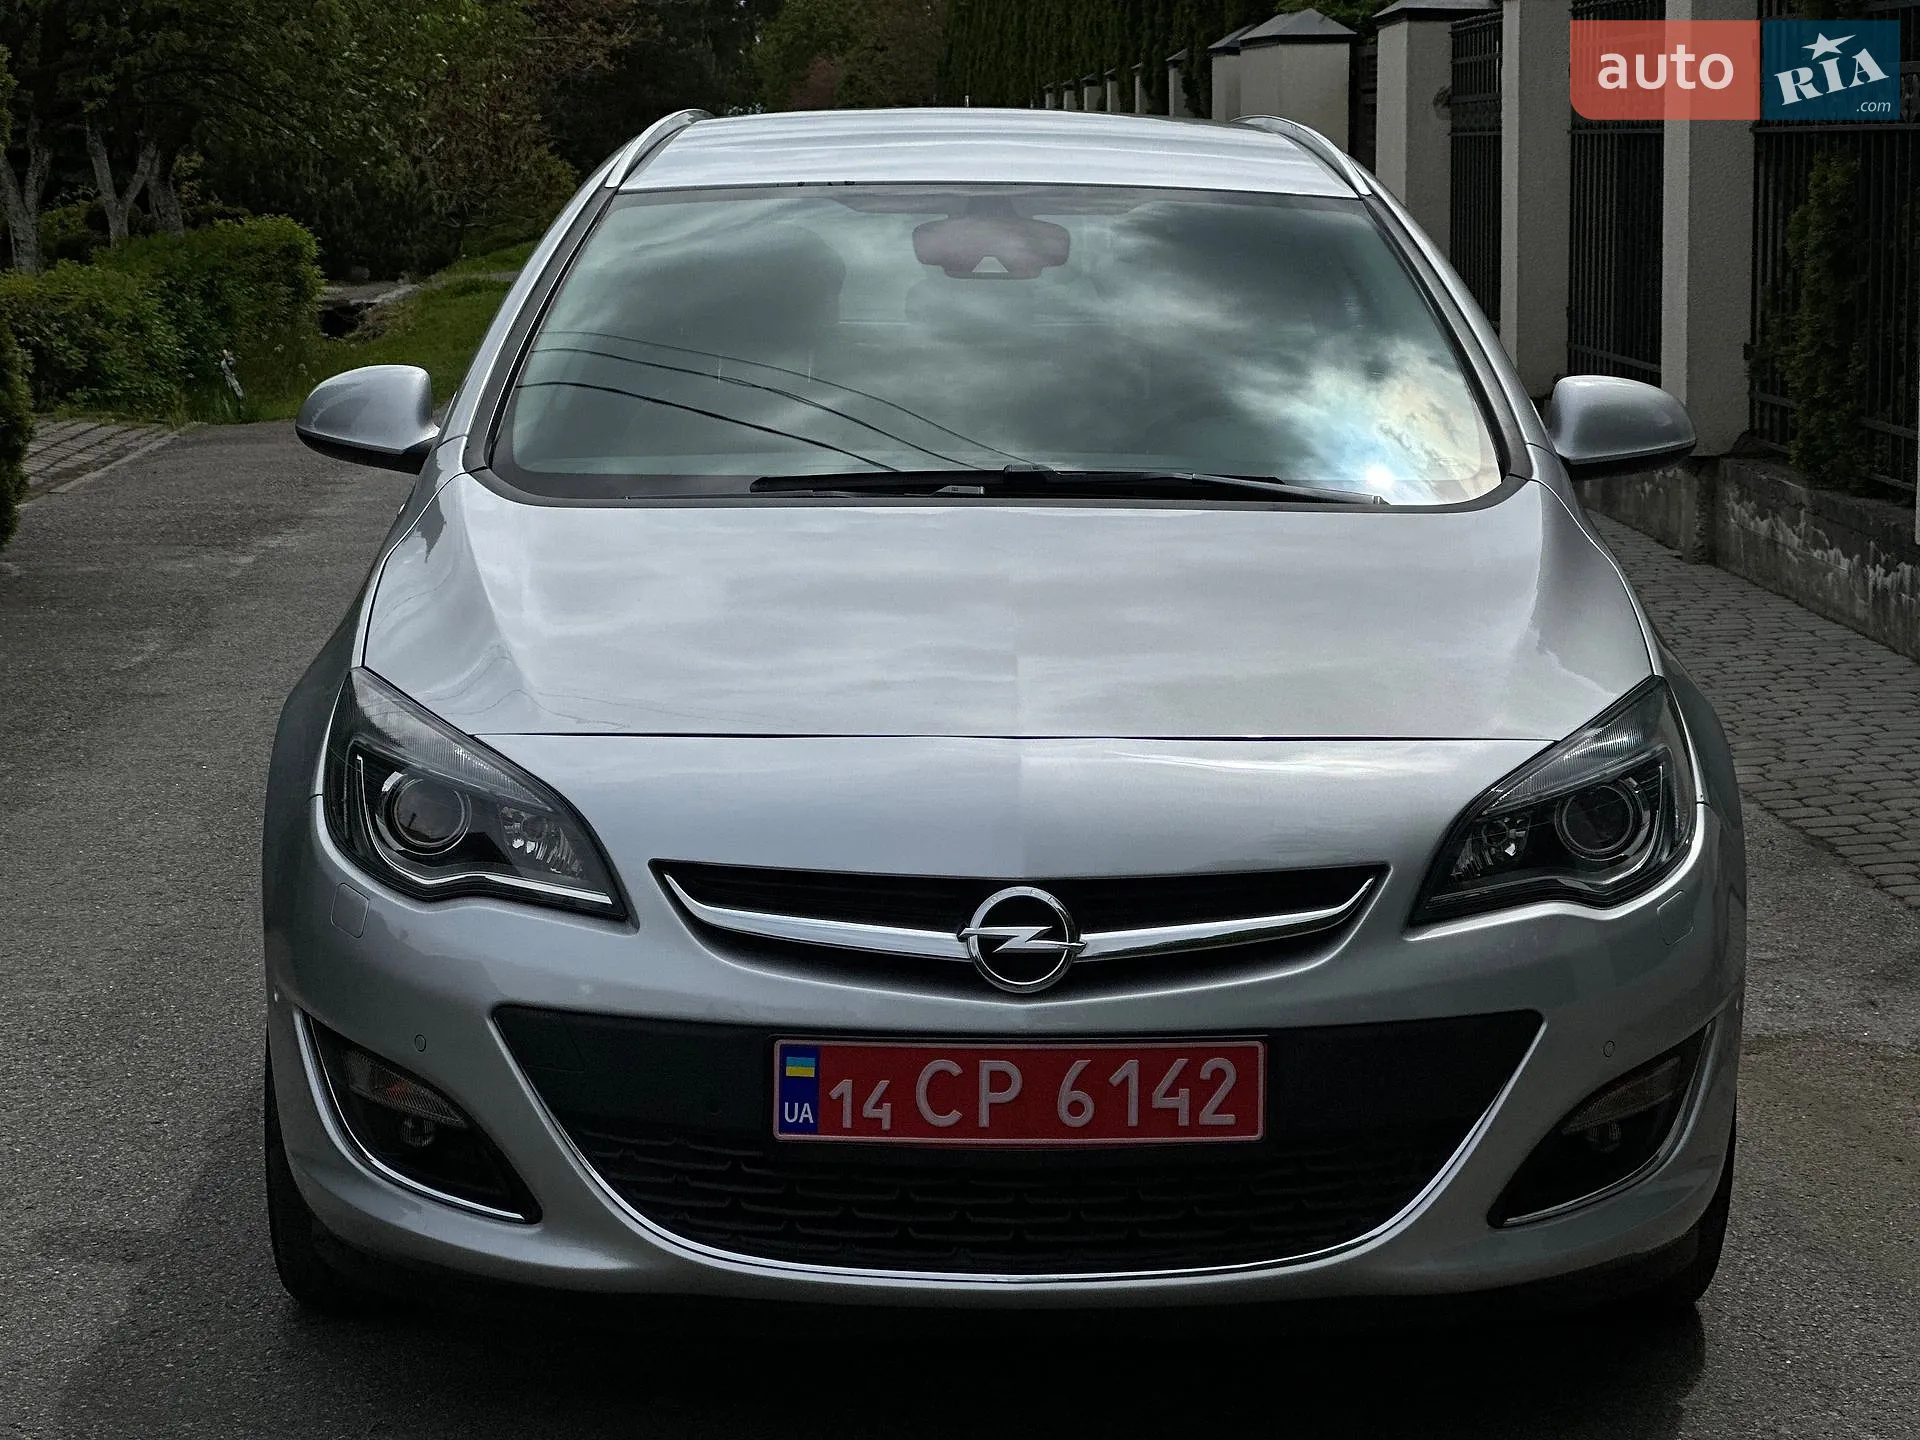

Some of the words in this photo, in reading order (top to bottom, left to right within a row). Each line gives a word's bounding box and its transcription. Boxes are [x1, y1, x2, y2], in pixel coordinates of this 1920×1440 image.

[784, 1102, 814, 1125] UA
[828, 1079, 892, 1130] 14
[915, 1059, 1023, 1128] CP
[1056, 1058, 1237, 1128] 6142
